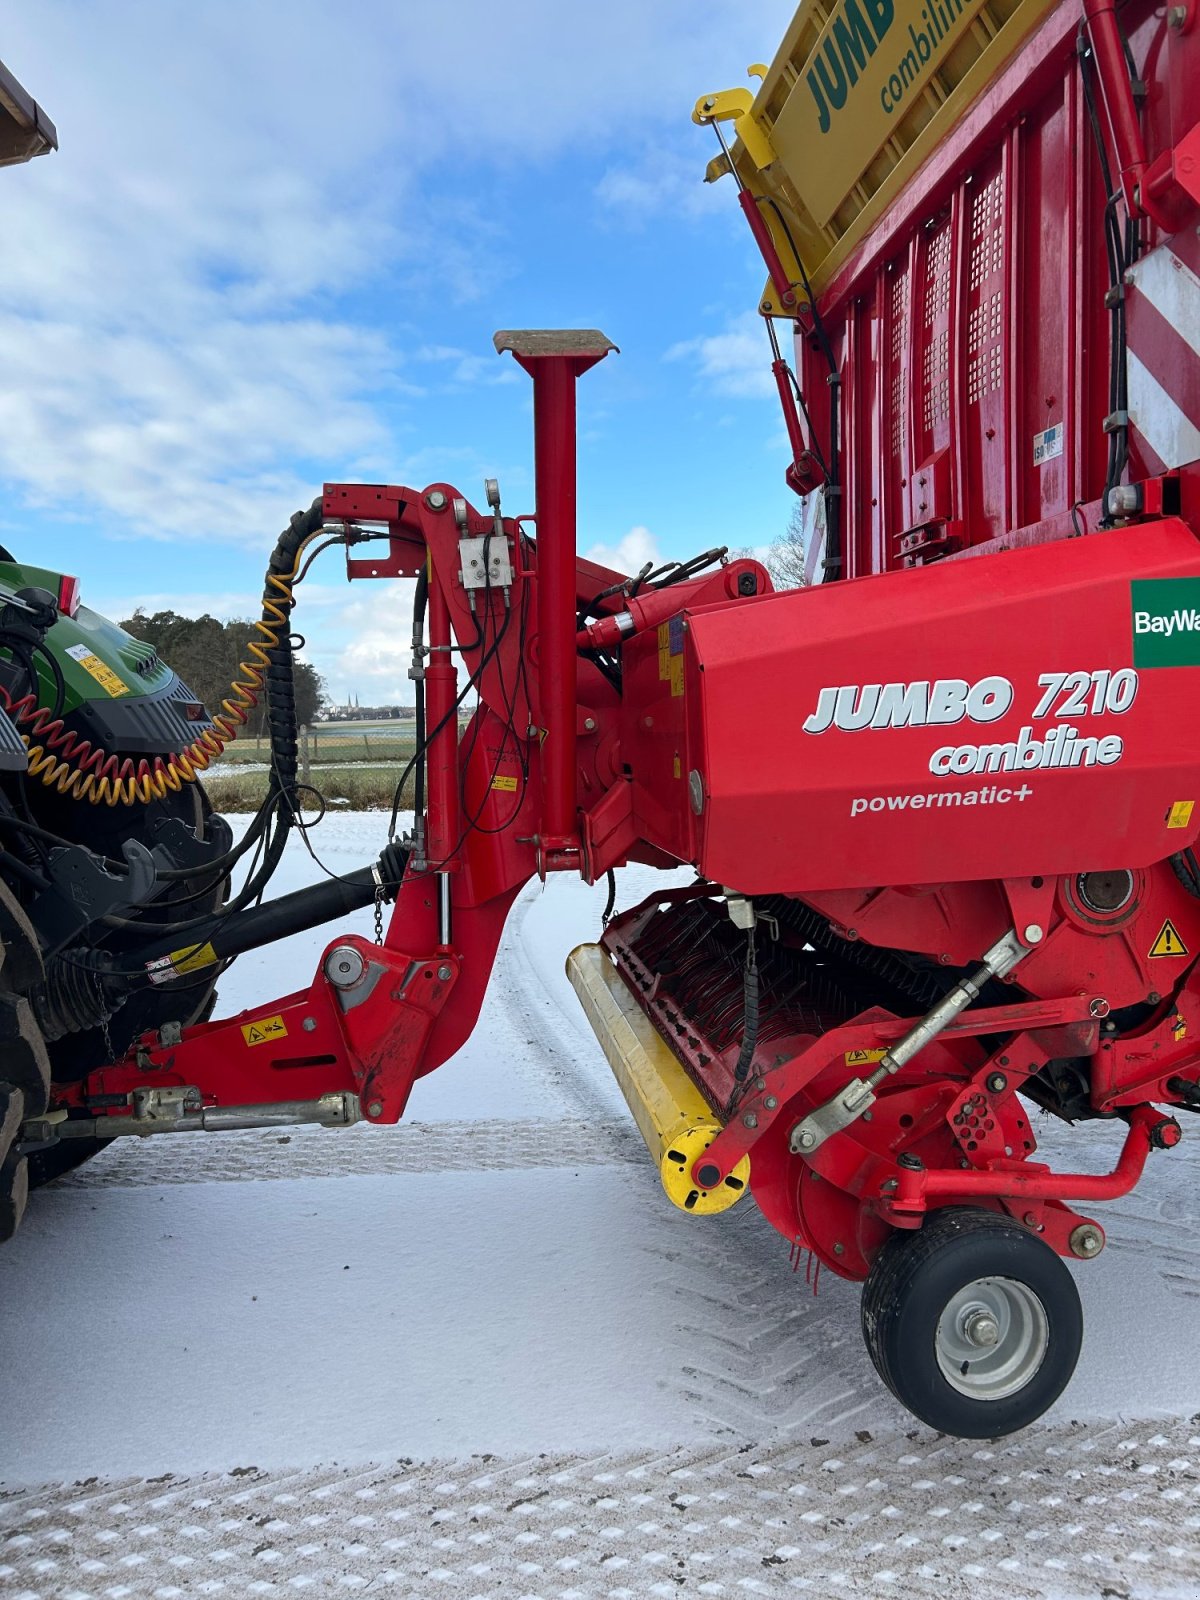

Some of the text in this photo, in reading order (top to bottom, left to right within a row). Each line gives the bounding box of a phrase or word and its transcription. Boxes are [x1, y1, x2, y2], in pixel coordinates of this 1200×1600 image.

[880, 0, 972, 114] combilin
[803, 668, 1138, 735] JUMBO 7210
[929, 724, 1123, 777] combiline
[851, 784, 1033, 817] powermatic+
